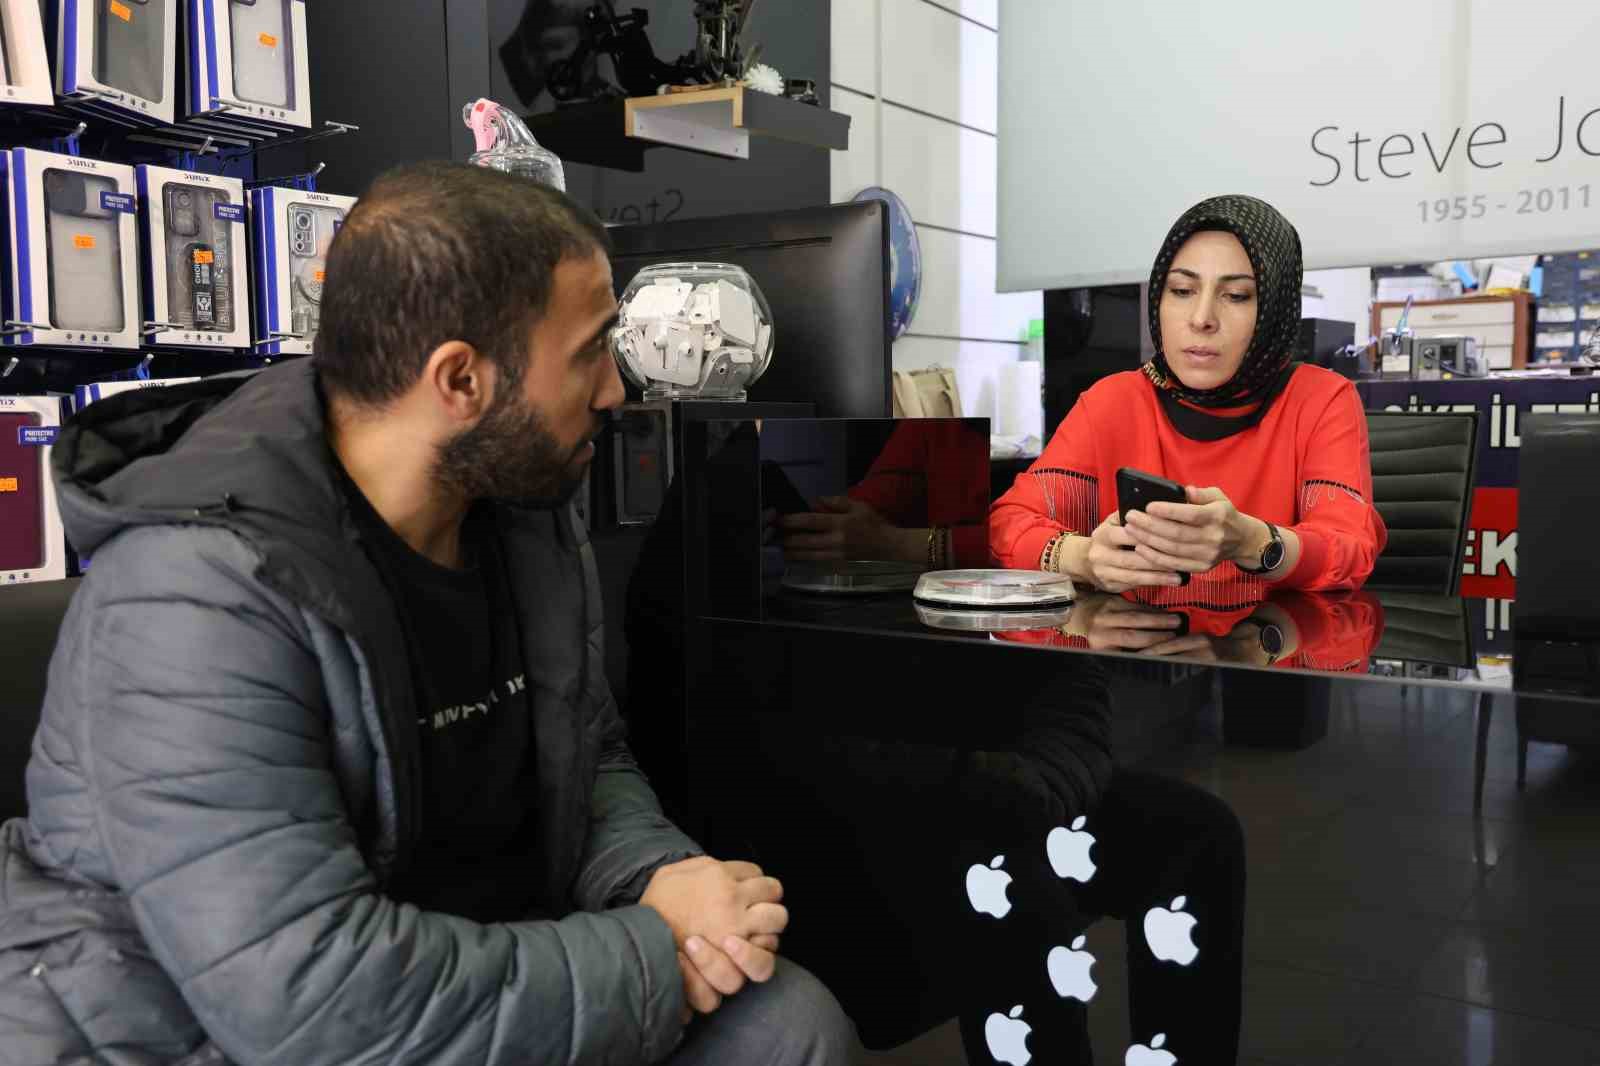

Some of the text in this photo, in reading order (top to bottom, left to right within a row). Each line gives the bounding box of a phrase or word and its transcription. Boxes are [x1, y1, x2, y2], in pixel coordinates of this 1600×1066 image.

[1309, 122, 1507, 187] Steve
[1416, 194, 1487, 224] 1955
[1516, 183, 1592, 215] 2011
